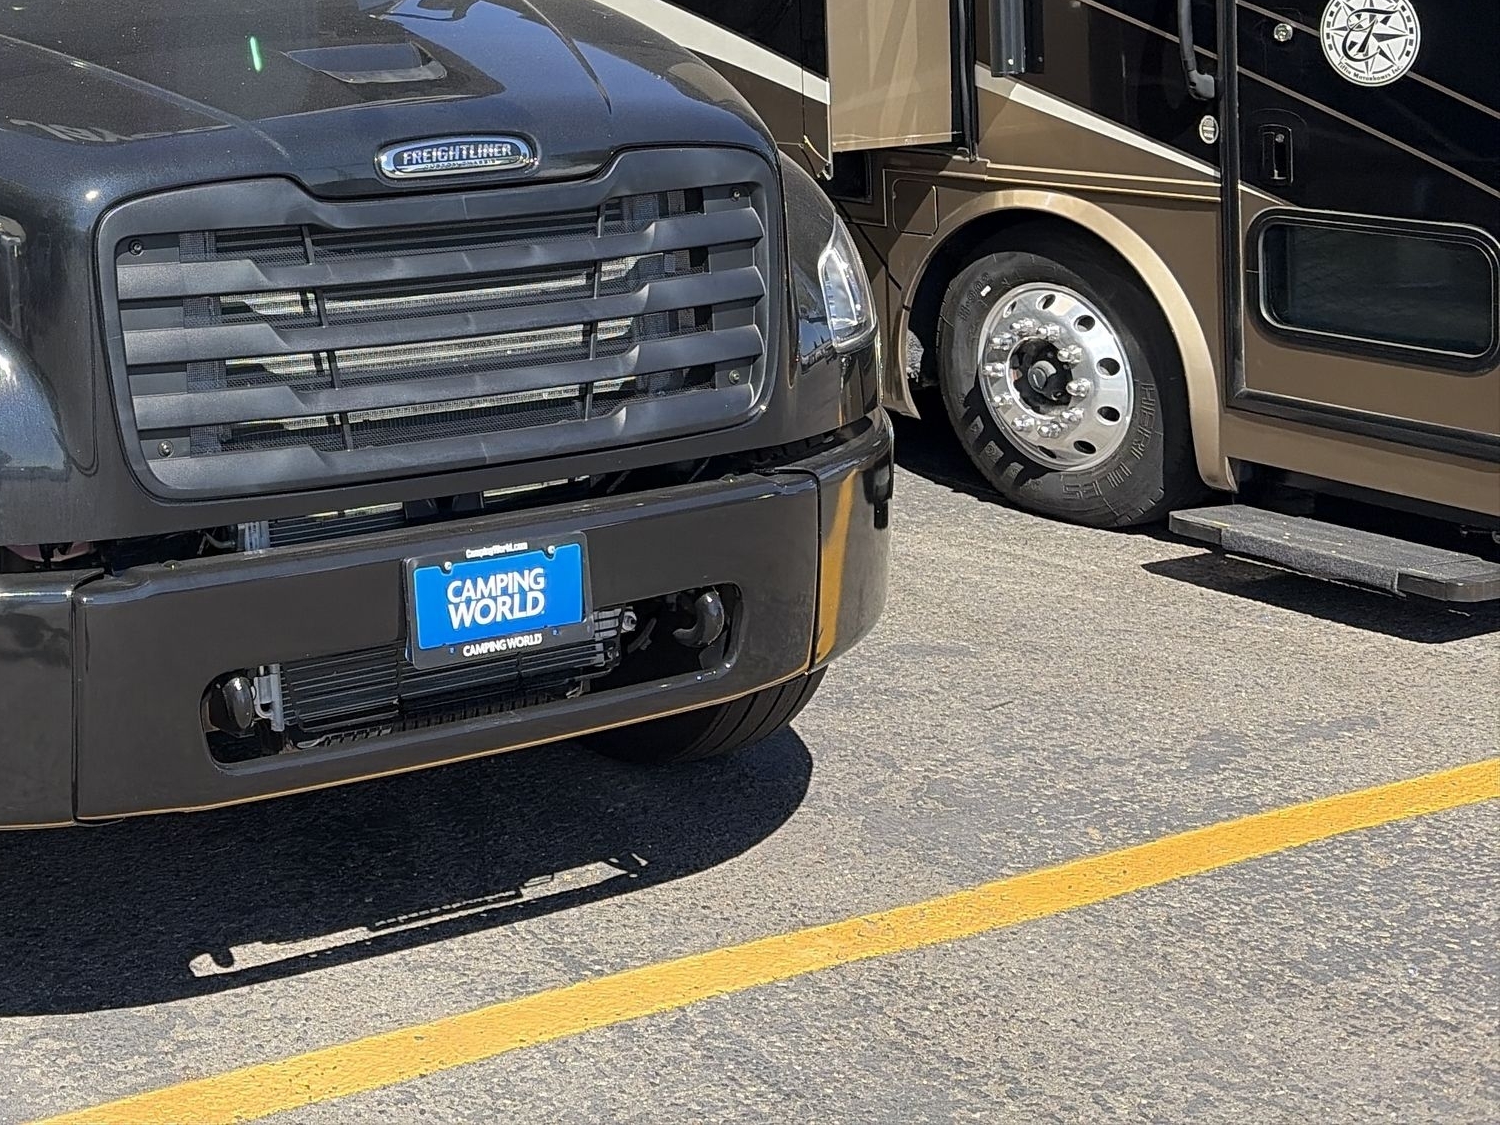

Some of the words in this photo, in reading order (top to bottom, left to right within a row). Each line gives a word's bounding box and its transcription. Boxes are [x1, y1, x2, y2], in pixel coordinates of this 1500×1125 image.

[403, 143, 512, 165] FREIGHTLINER
[447, 567, 545, 603] CAMPING
[448, 591, 545, 630] WORLD
[462, 639, 507, 657] CAMPING
[507, 633, 543, 649] WORLD
